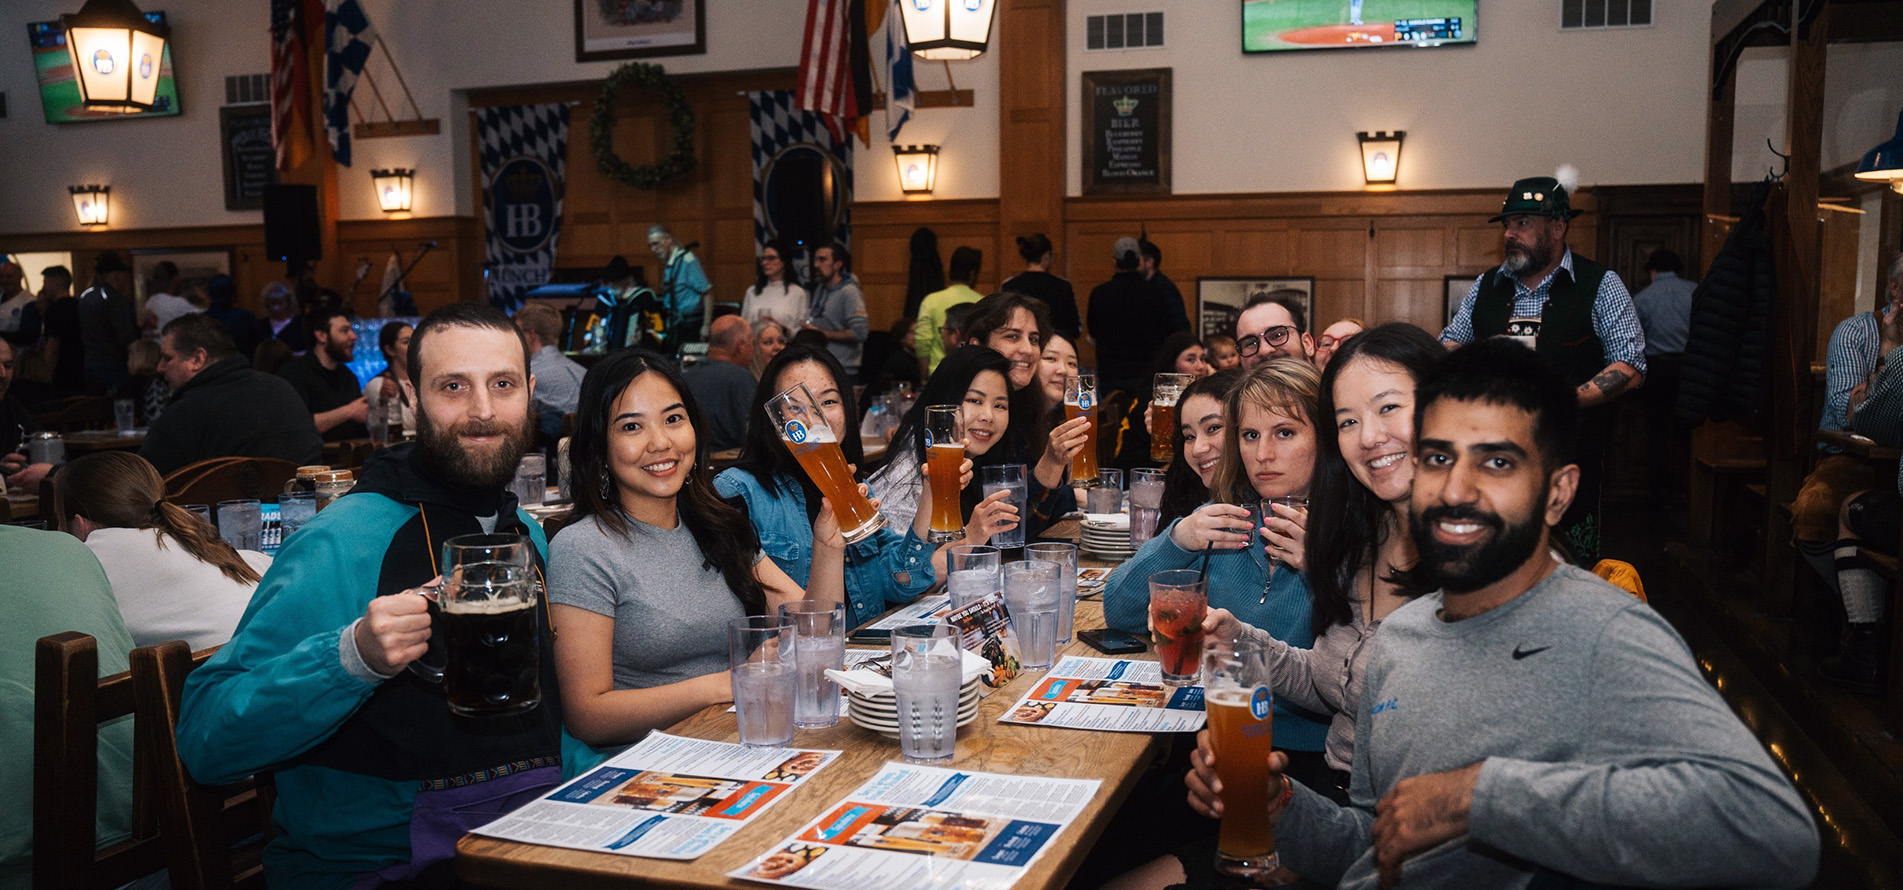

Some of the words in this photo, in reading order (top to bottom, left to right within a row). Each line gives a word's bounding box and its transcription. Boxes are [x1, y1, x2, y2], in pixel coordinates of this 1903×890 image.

[1095, 85, 1157, 96] FLAVORED
[1111, 119, 1139, 128] BIER
[1105, 130, 1143, 138] BLUEBERRY
[1106, 138, 1143, 146] RASPBERRY
[1126, 168, 1155, 176] ORANGE
[506, 203, 543, 238] HB
[1081, 400, 1091, 408] HB
[791, 429, 806, 442] HB
[1256, 700, 1269, 716] HB
